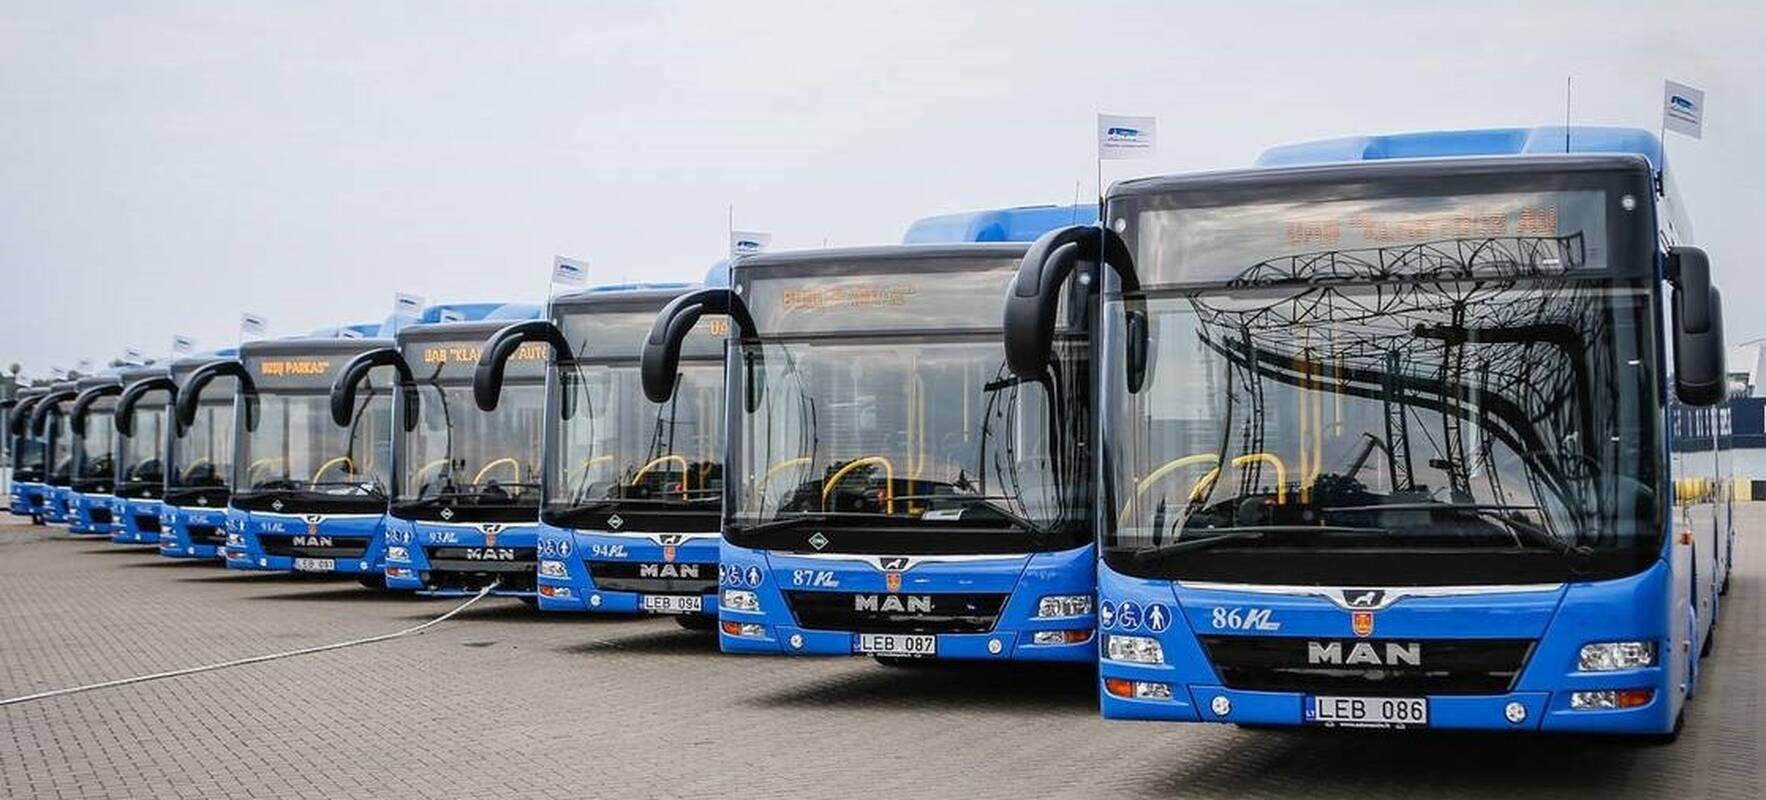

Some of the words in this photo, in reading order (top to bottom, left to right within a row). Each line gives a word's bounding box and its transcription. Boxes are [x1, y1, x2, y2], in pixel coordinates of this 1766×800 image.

[293, 536, 333, 546] MAN
[466, 548, 515, 560] MAN
[640, 564, 699, 578] MAN
[646, 597, 671, 609] LEB
[679, 598, 700, 609] 094
[855, 595, 932, 612] MAN
[862, 636, 895, 651] LEB
[905, 637, 933, 651] 087
[1308, 641, 1421, 665] MAN
[1319, 699, 1366, 719] LEB
[1382, 700, 1423, 721] 086
